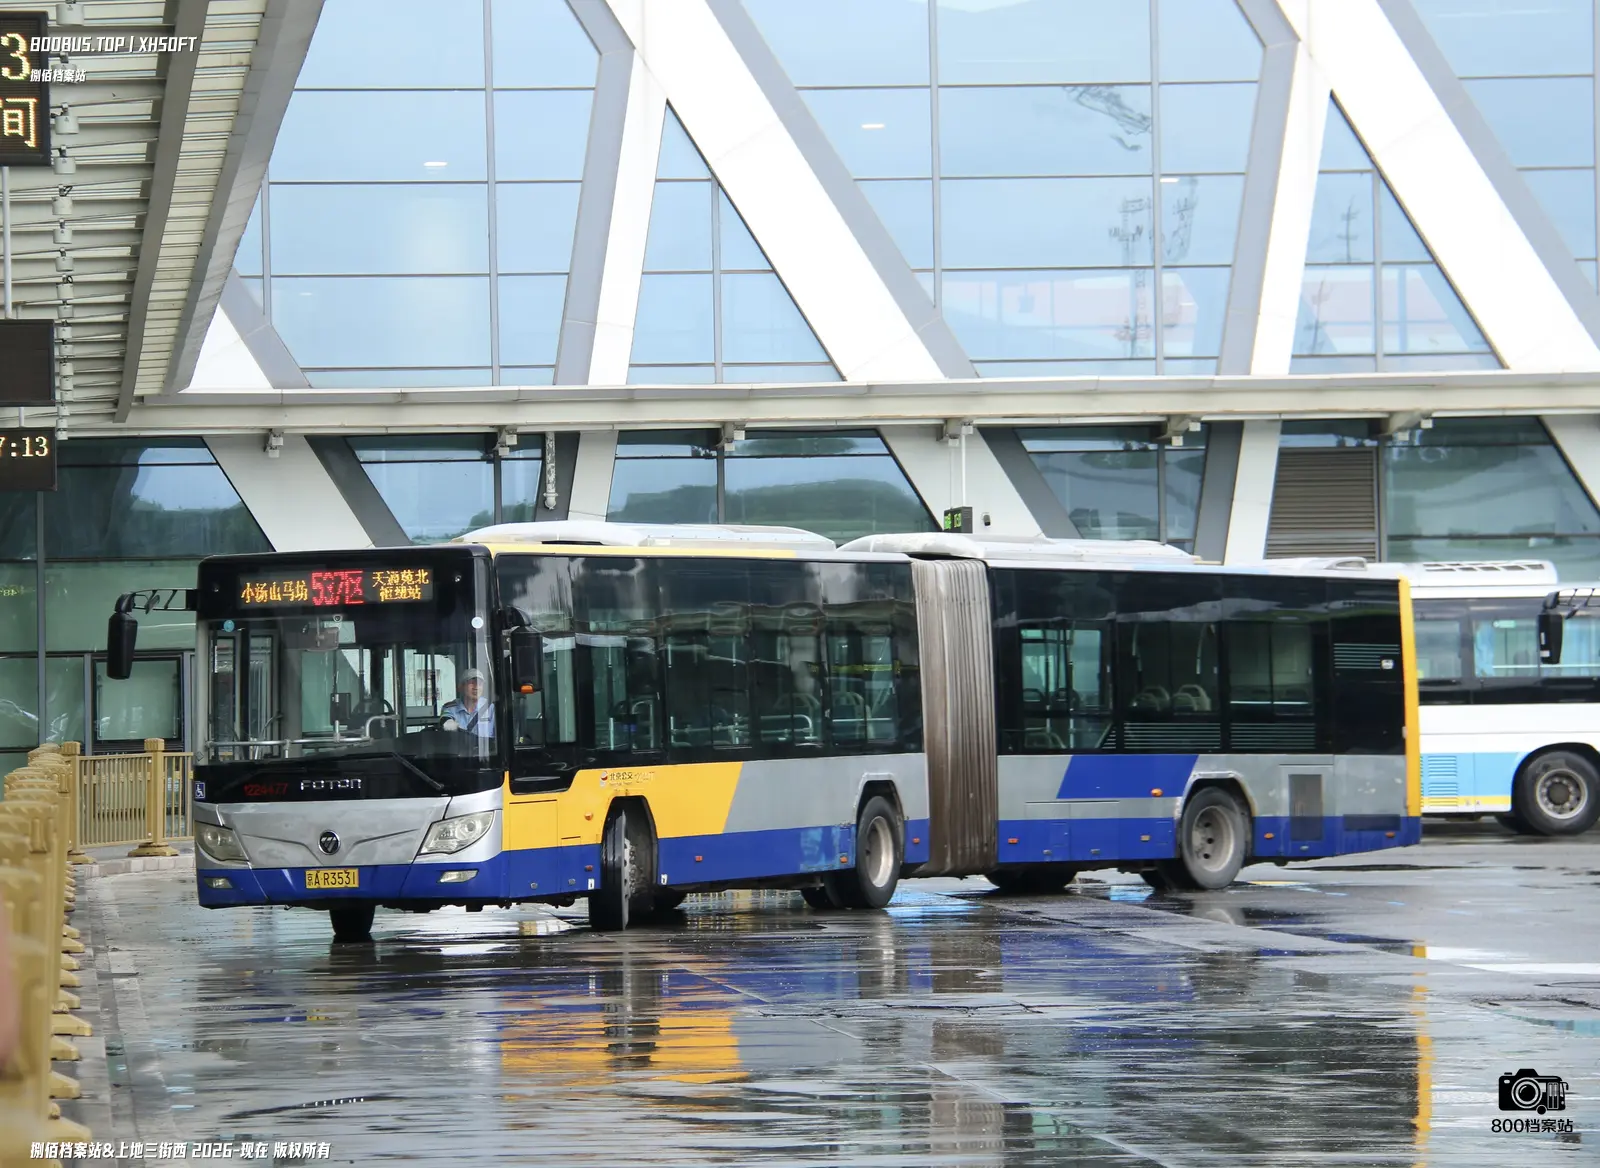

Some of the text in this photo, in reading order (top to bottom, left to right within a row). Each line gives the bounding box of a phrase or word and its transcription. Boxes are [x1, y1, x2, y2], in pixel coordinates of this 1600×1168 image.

[372, 569, 430, 588] 天通苑北
[240, 580, 308, 604] 小汤山马坊
[379, 585, 422, 602] 枢纽站
[300, 779, 362, 791] FOTON
